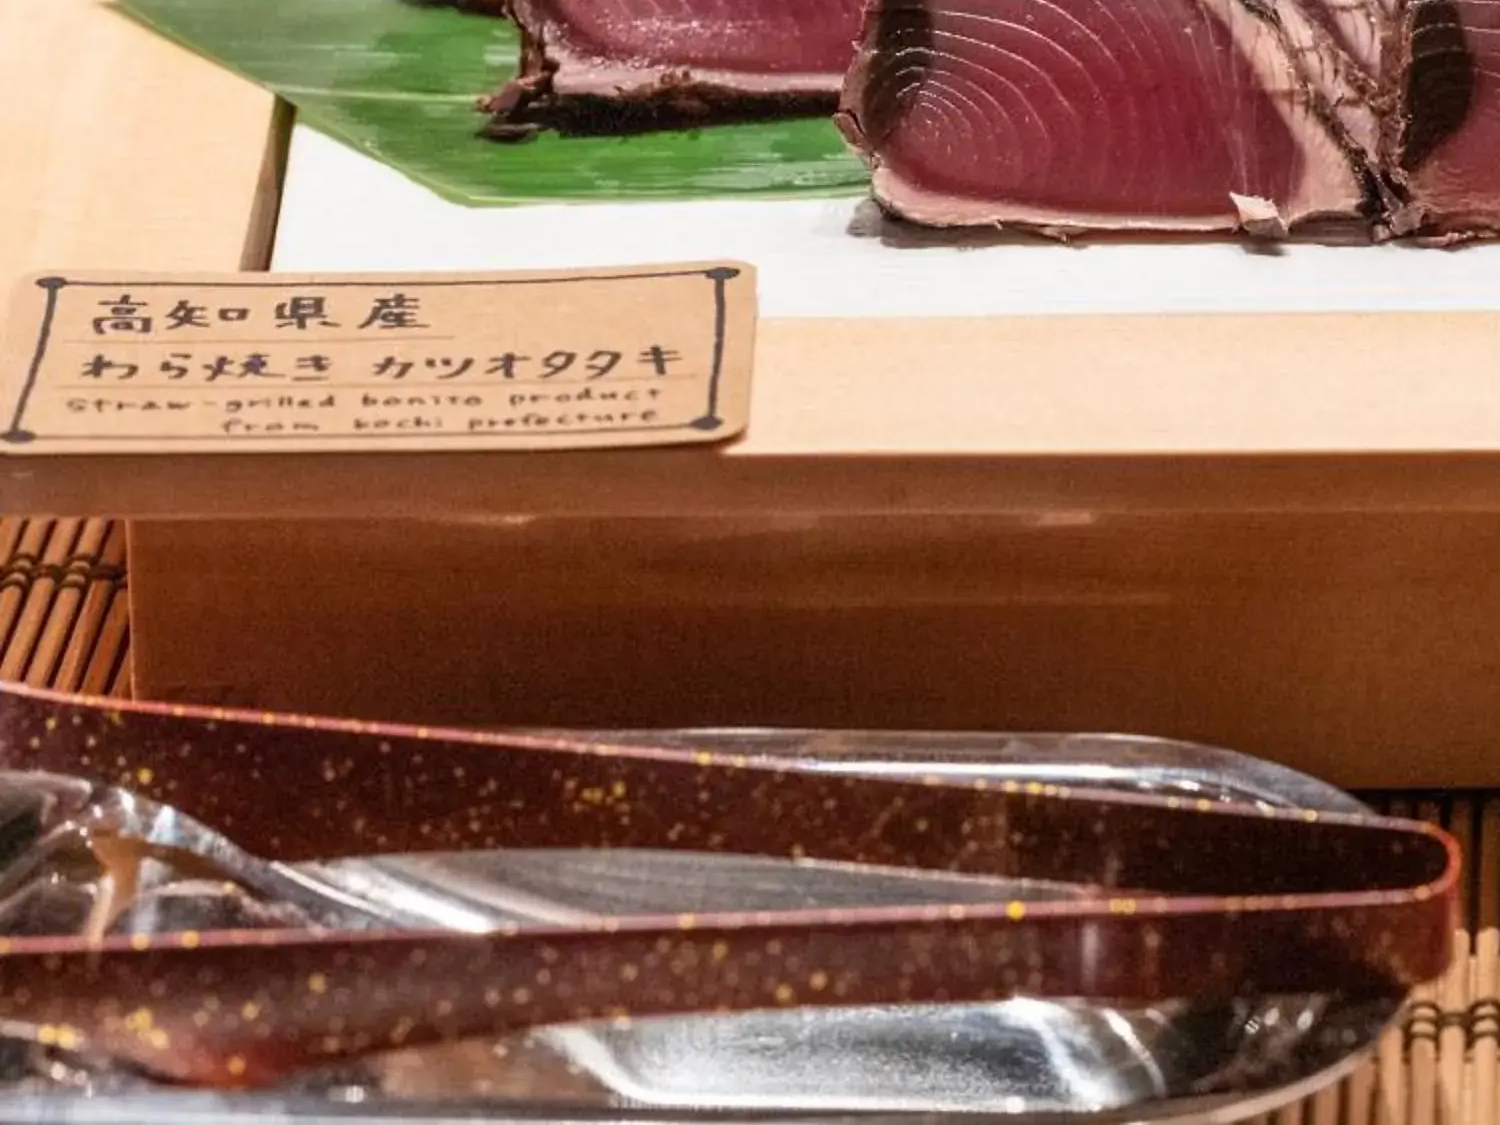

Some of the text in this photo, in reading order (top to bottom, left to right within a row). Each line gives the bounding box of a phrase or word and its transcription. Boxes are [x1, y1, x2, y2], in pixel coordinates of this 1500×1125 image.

[92, 293, 430, 334] 高知県産
[80, 344, 683, 382] わら焼き カツオタタキ
[361, 391, 484, 408] bonito
[509, 386, 663, 408] product
[221, 417, 320, 434] from
[468, 409, 659, 432] prefecture
